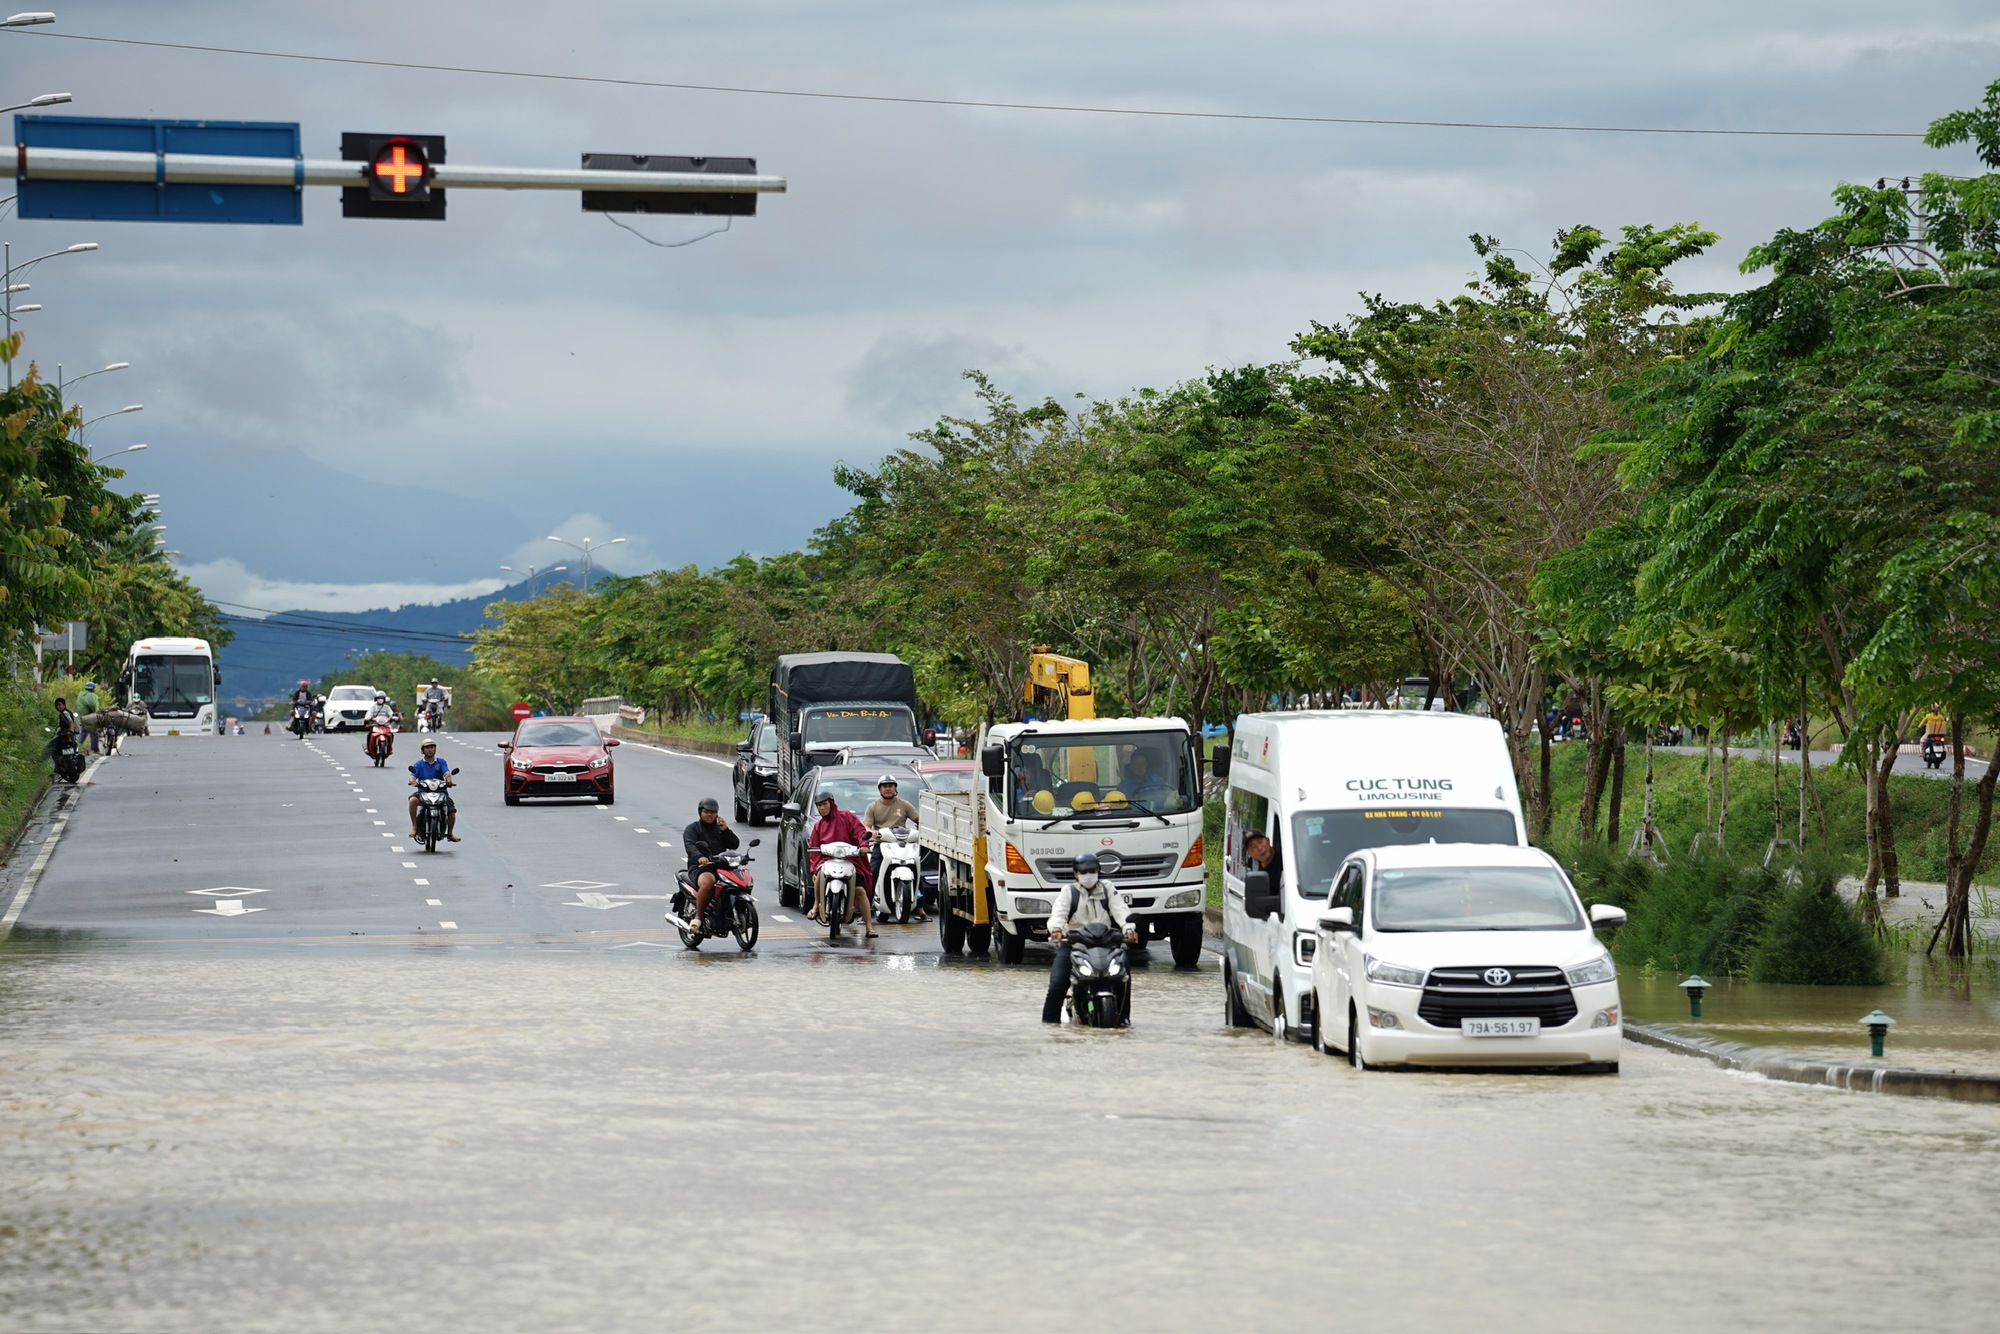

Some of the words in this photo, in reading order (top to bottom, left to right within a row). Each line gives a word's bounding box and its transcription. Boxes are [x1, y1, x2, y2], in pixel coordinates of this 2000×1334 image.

[1359, 792, 1442, 801] LIMOUSINE
[1374, 810, 1387, 818] NHA
[1387, 810, 1408, 818] TRANG
[1030, 847, 1065, 855] HINO
